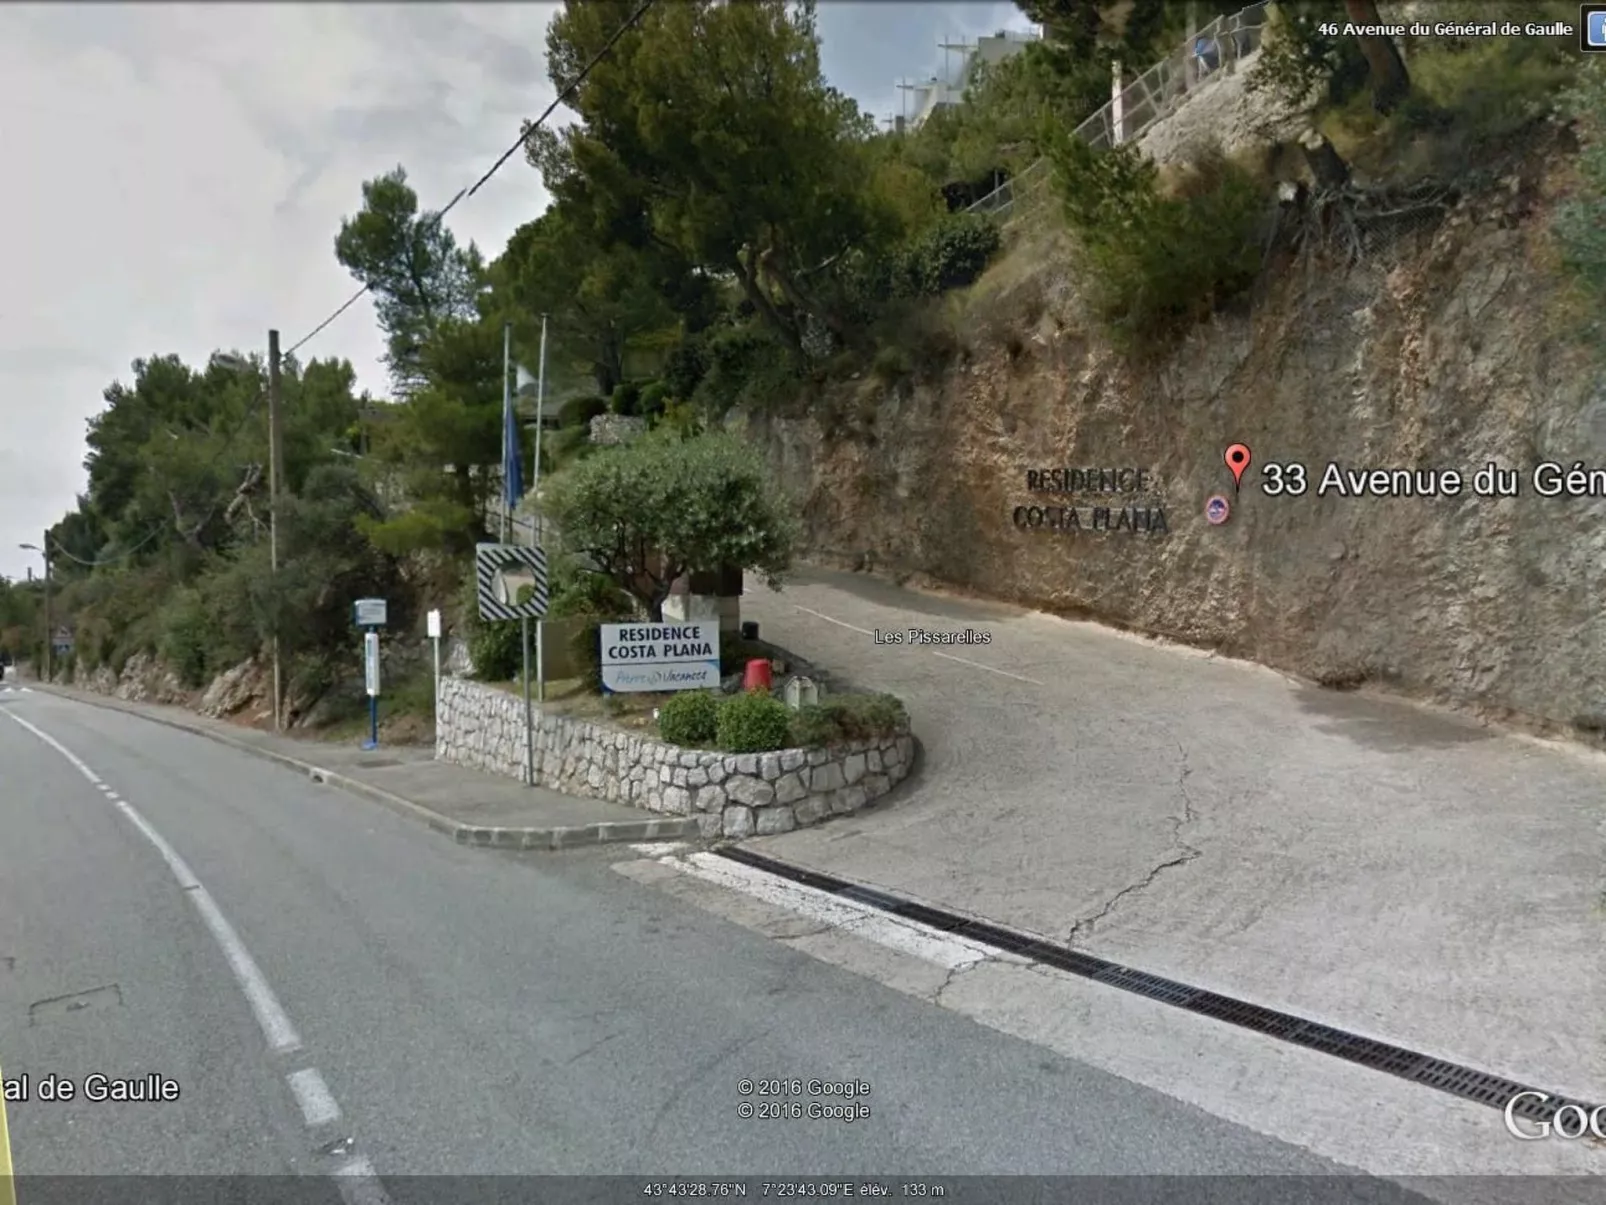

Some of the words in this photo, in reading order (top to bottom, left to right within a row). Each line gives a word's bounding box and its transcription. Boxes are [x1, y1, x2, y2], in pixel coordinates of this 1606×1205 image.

[1026, 467, 1150, 492] RESIDENCE
[619, 626, 701, 642] RESIDENCE
[608, 645, 657, 659] COSTA
[663, 642, 713, 657] PLANA
